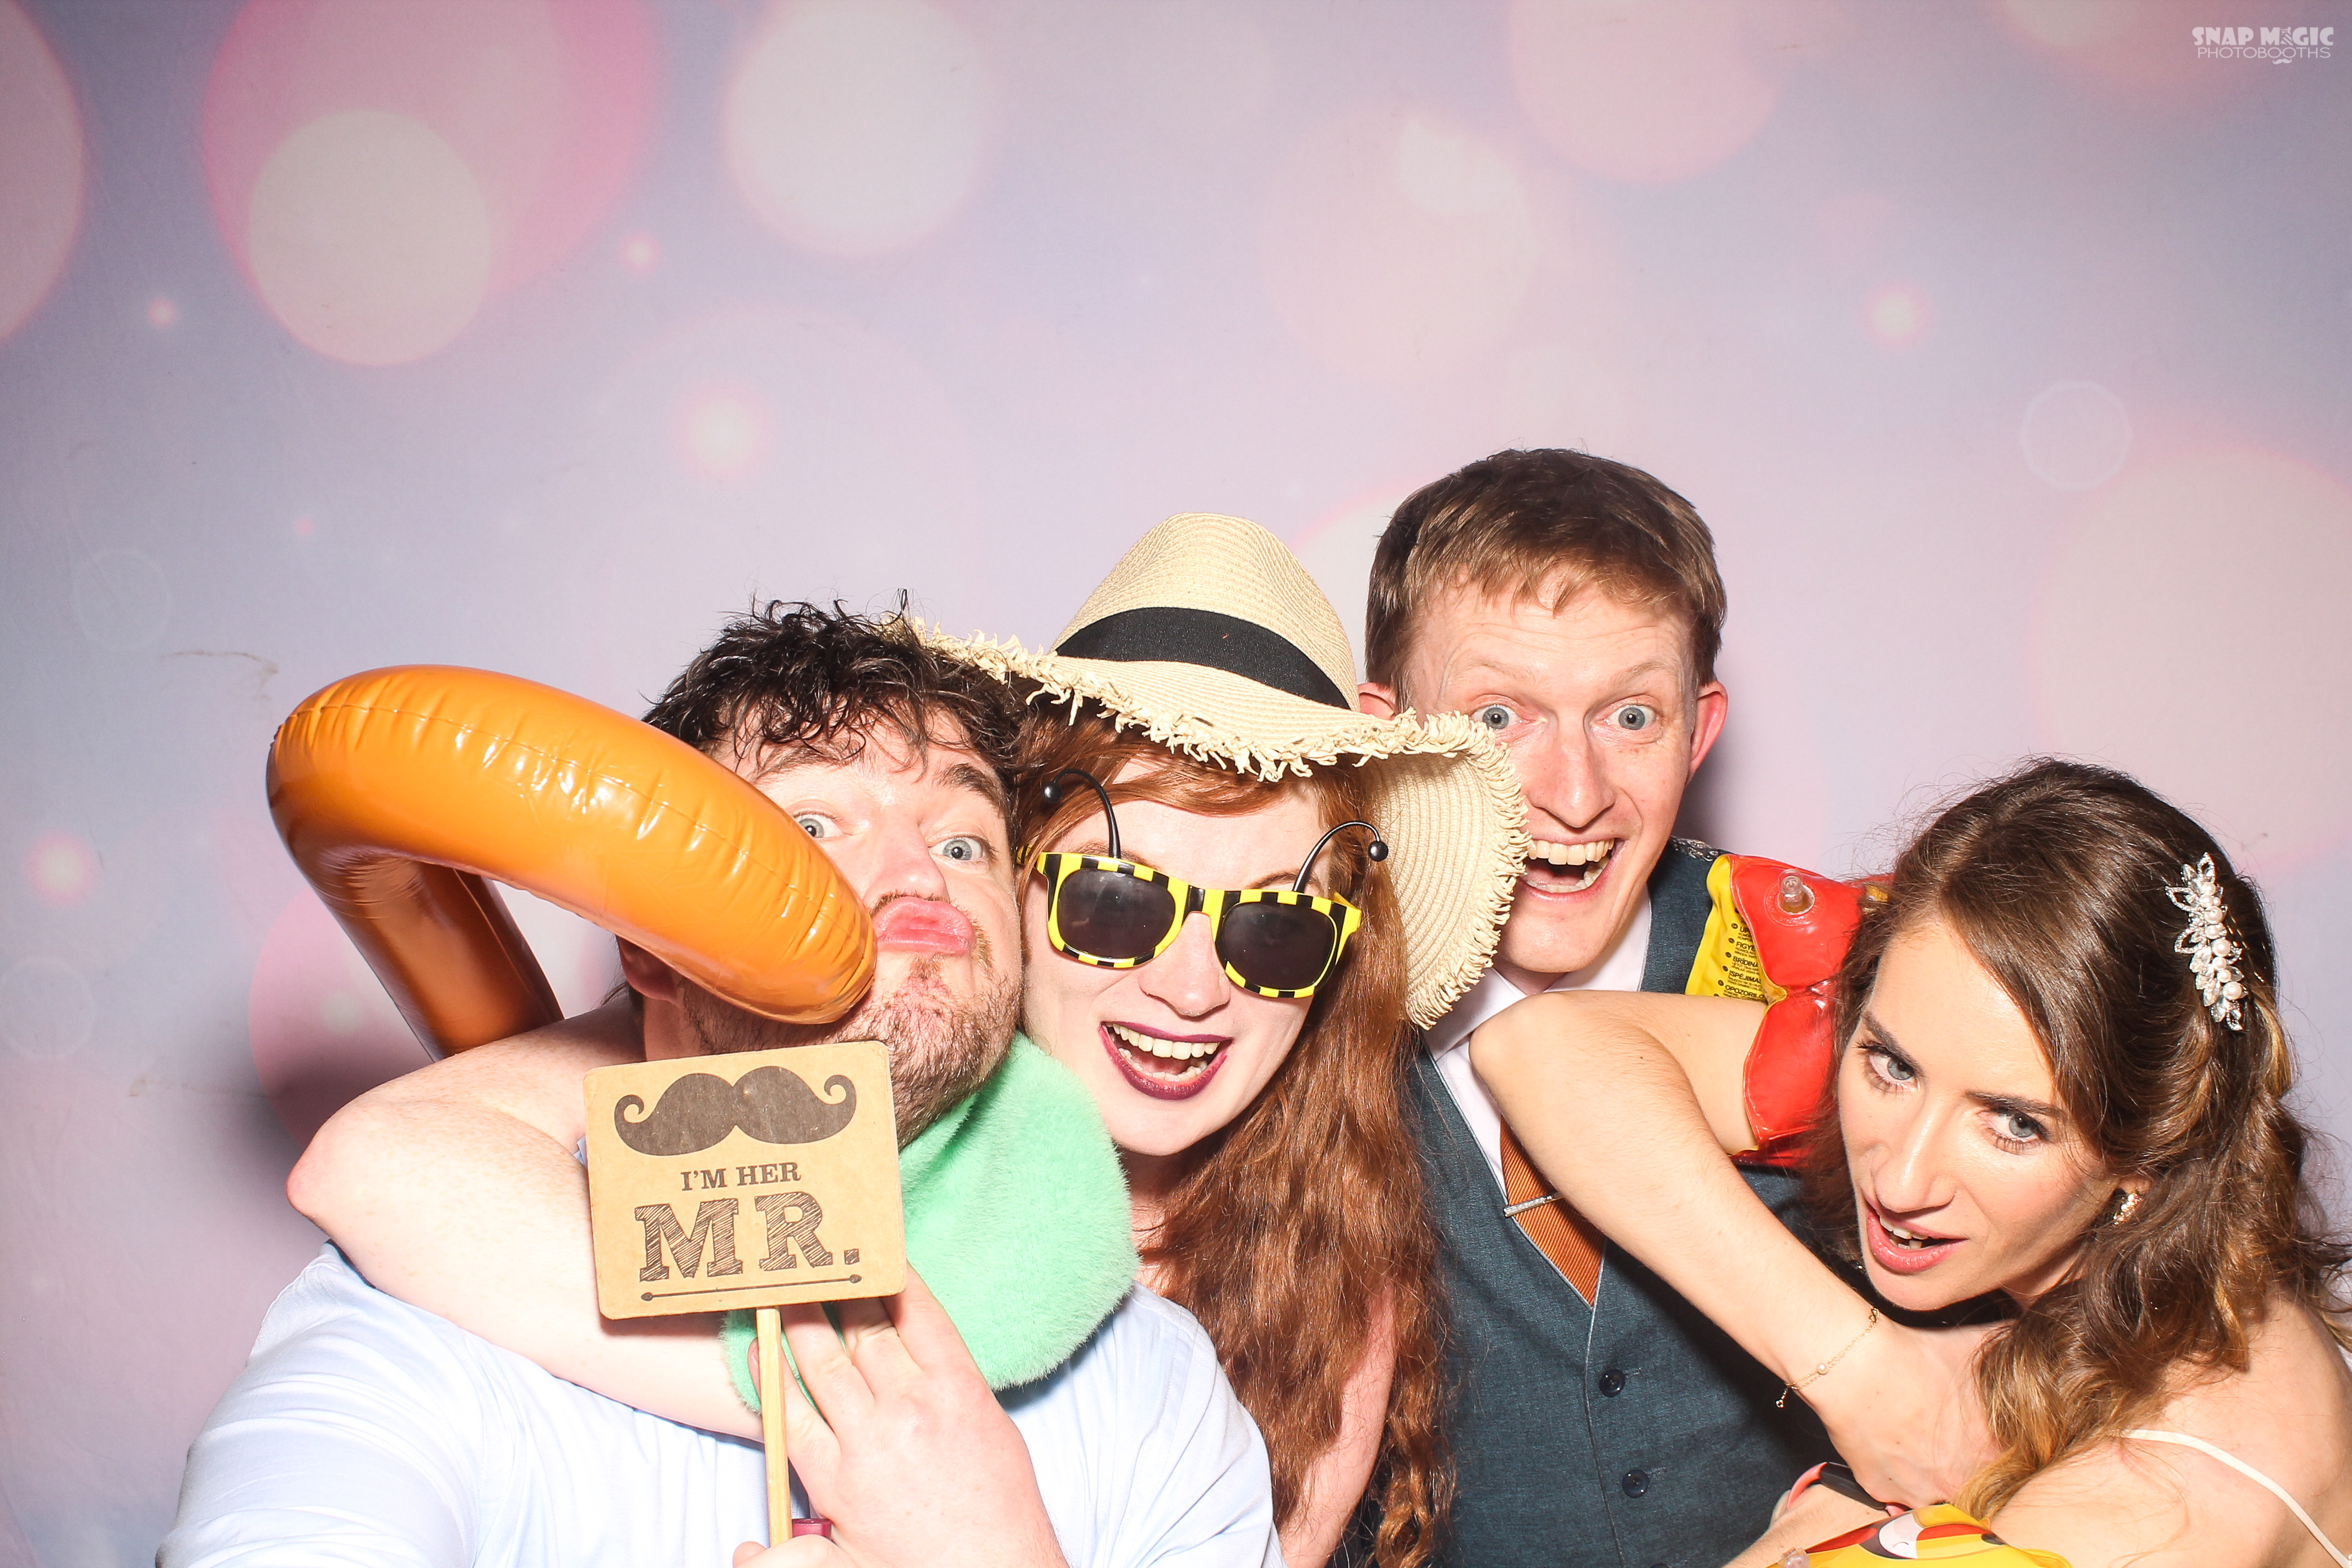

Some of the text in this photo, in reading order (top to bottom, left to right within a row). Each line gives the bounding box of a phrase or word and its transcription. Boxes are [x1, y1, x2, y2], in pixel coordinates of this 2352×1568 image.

[1725, 985, 1765, 999] OPOZORILO
[680, 1162, 802, 1191] I'M HER
[634, 1191, 860, 1282] MR.
